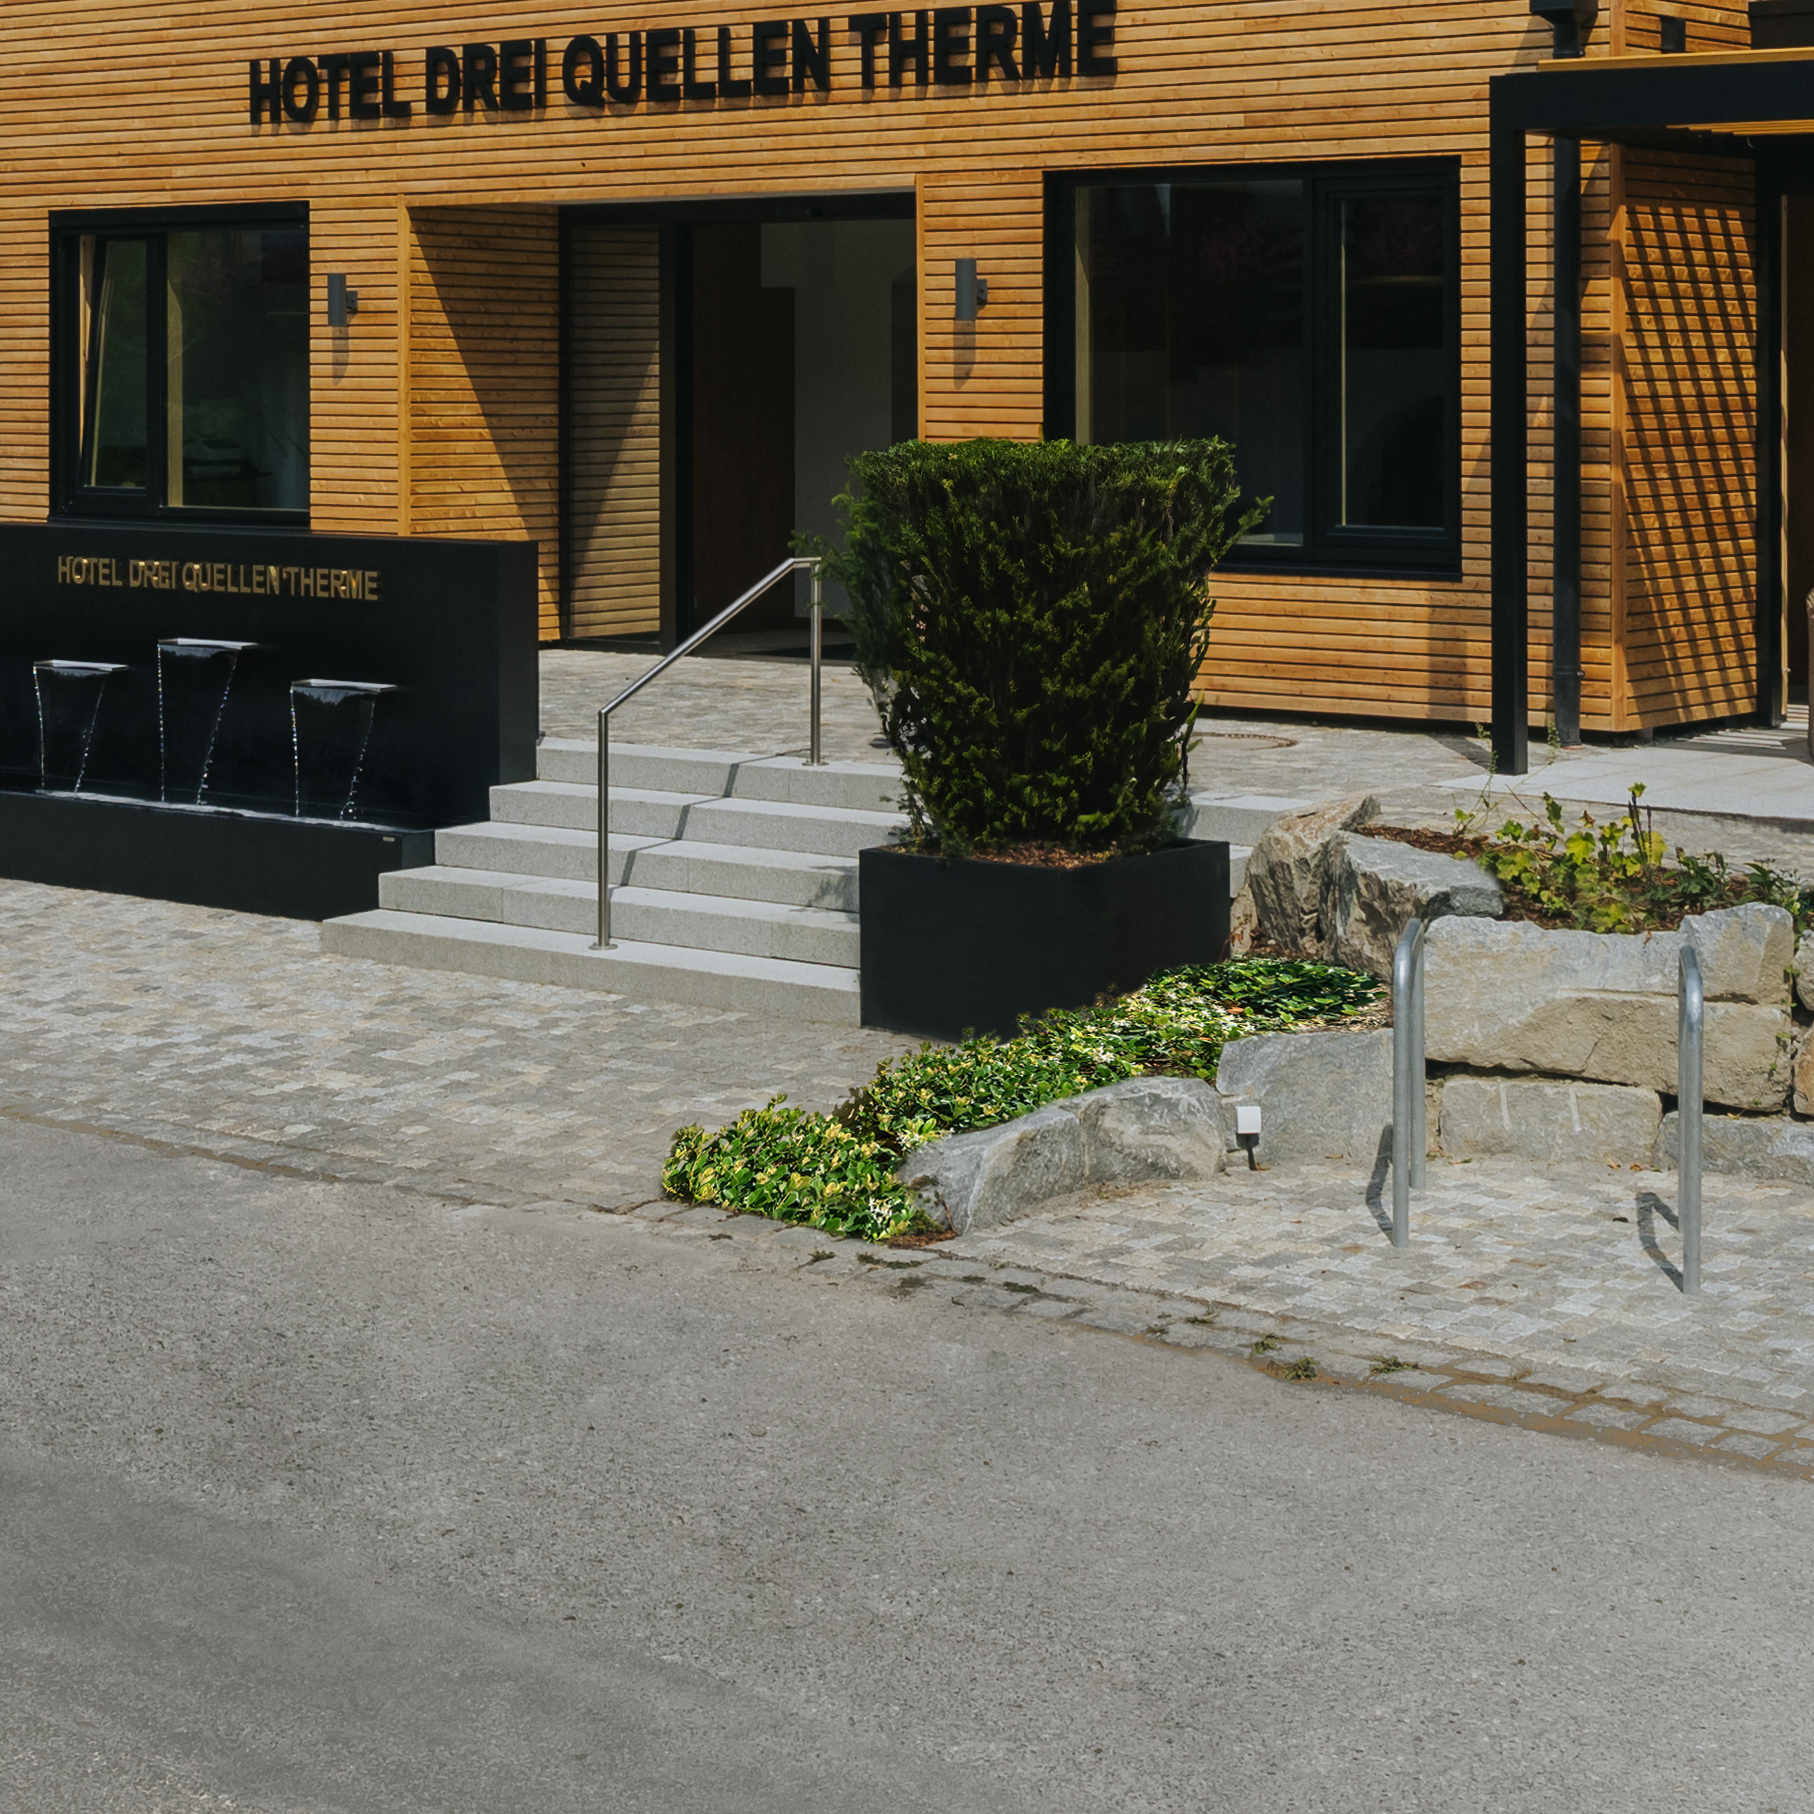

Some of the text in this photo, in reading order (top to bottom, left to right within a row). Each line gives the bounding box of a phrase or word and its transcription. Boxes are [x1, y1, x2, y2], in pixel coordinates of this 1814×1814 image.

[249, 50, 410, 125] HOTEL
[424, 39, 546, 112] DREI
[562, 18, 831, 108] QUELLEN
[58, 556, 379, 601] HOTEL DREI QUELLEN THERME
